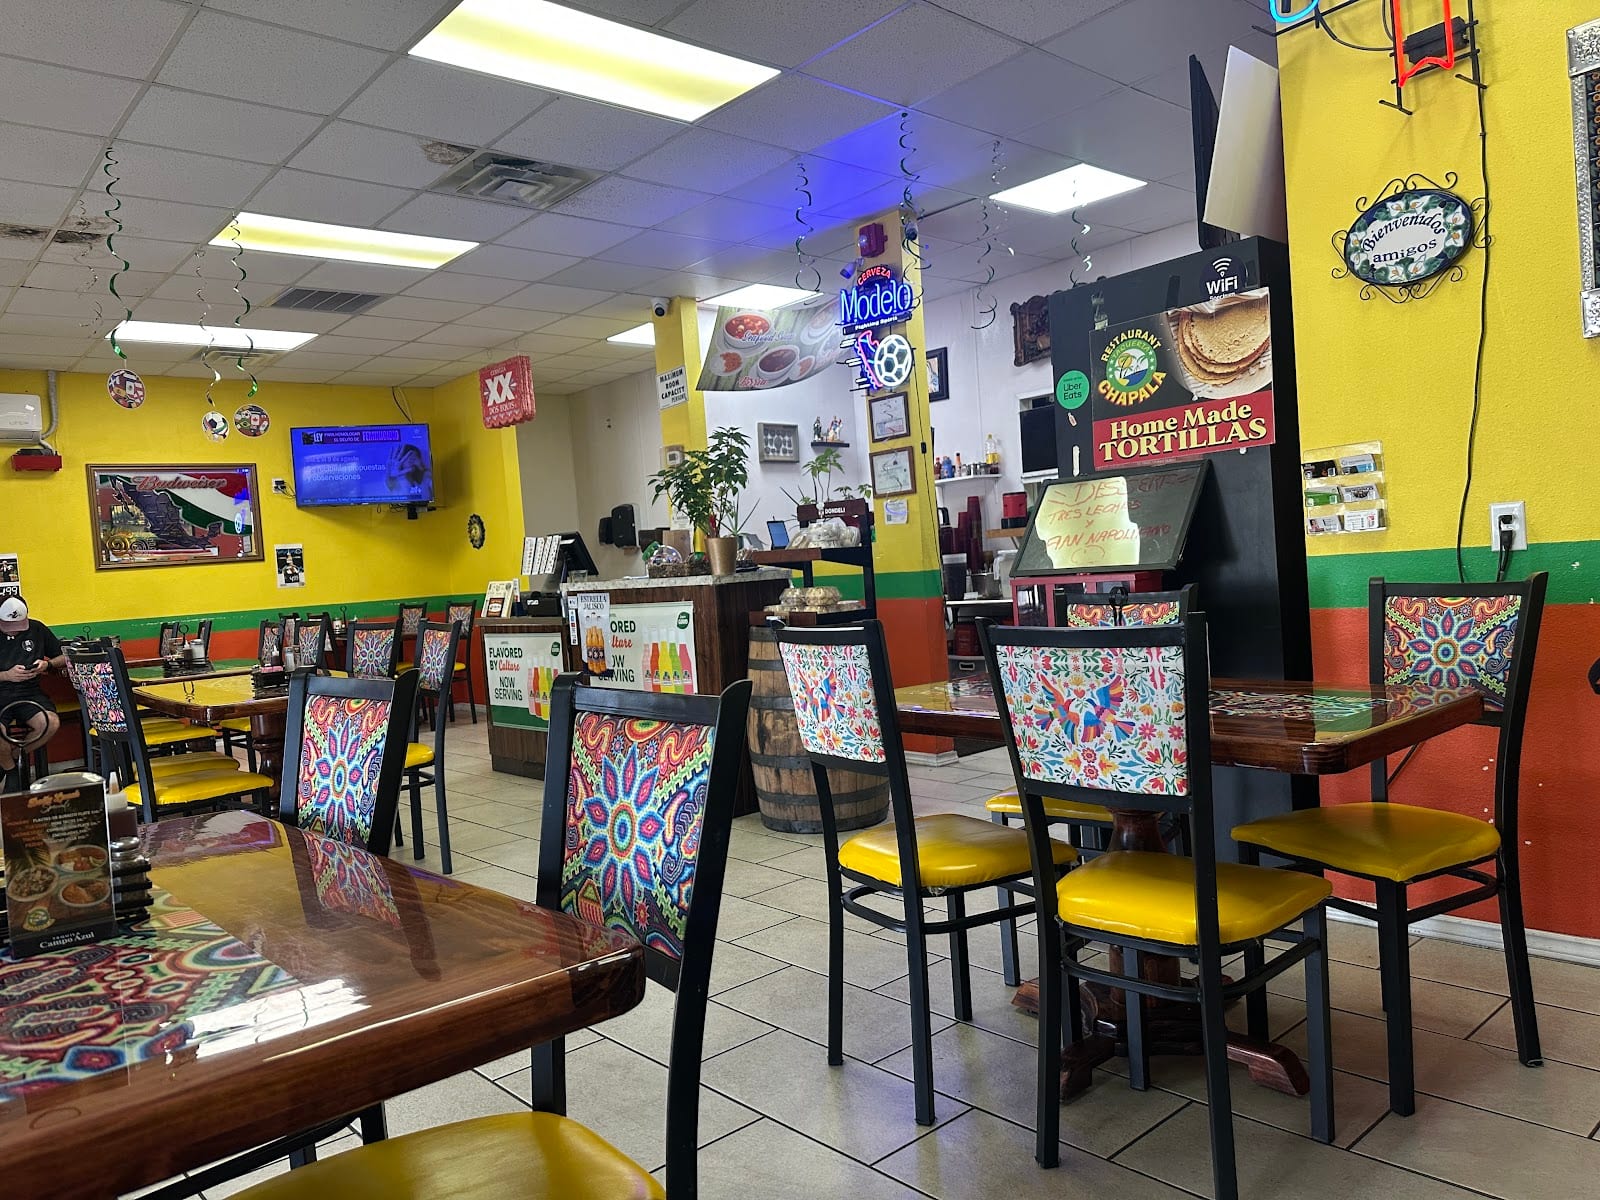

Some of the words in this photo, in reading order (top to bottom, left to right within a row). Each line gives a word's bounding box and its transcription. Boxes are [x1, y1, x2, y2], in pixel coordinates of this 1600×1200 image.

[1362, 212, 1446, 252] Bienvenidos
[1372, 238, 1438, 263] amigos
[857, 266, 892, 286] CERVEZA
[1205, 275, 1238, 295] WiFi
[841, 280, 912, 324] Modelo
[855, 319, 880, 331] Fighting
[1100, 328, 1162, 363] RESTAURANT
[1110, 340, 1151, 359] TAQUERIA
[659, 368, 683, 383] MAXIMUM
[484, 371, 516, 407] XX
[665, 379, 680, 390] ROOM
[1063, 382, 1082, 392] Uber
[1097, 370, 1167, 407] CHAPALA
[661, 385, 685, 400] CAPACITY
[1063, 391, 1082, 400] Eats
[1110, 415, 1178, 441] Home
[1182, 400, 1252, 429] Made
[313, 432, 323, 443] LEY
[1098, 417, 1268, 462] TORTILLAS
[347, 464, 386, 475] propuestas
[132, 475, 228, 491] Budweiser
[1048, 509, 1082, 525] TRES
[580, 594, 607, 603] ESTRELLA
[583, 602, 605, 610] JALISCO
[488, 647, 523, 659] FLAVORED
[489, 660, 499, 670] BY
[499, 676, 516, 689] NOW
[494, 688, 523, 701] SERVING
[39, 937, 74, 949] Campo
[74, 930, 95, 942] Azul
